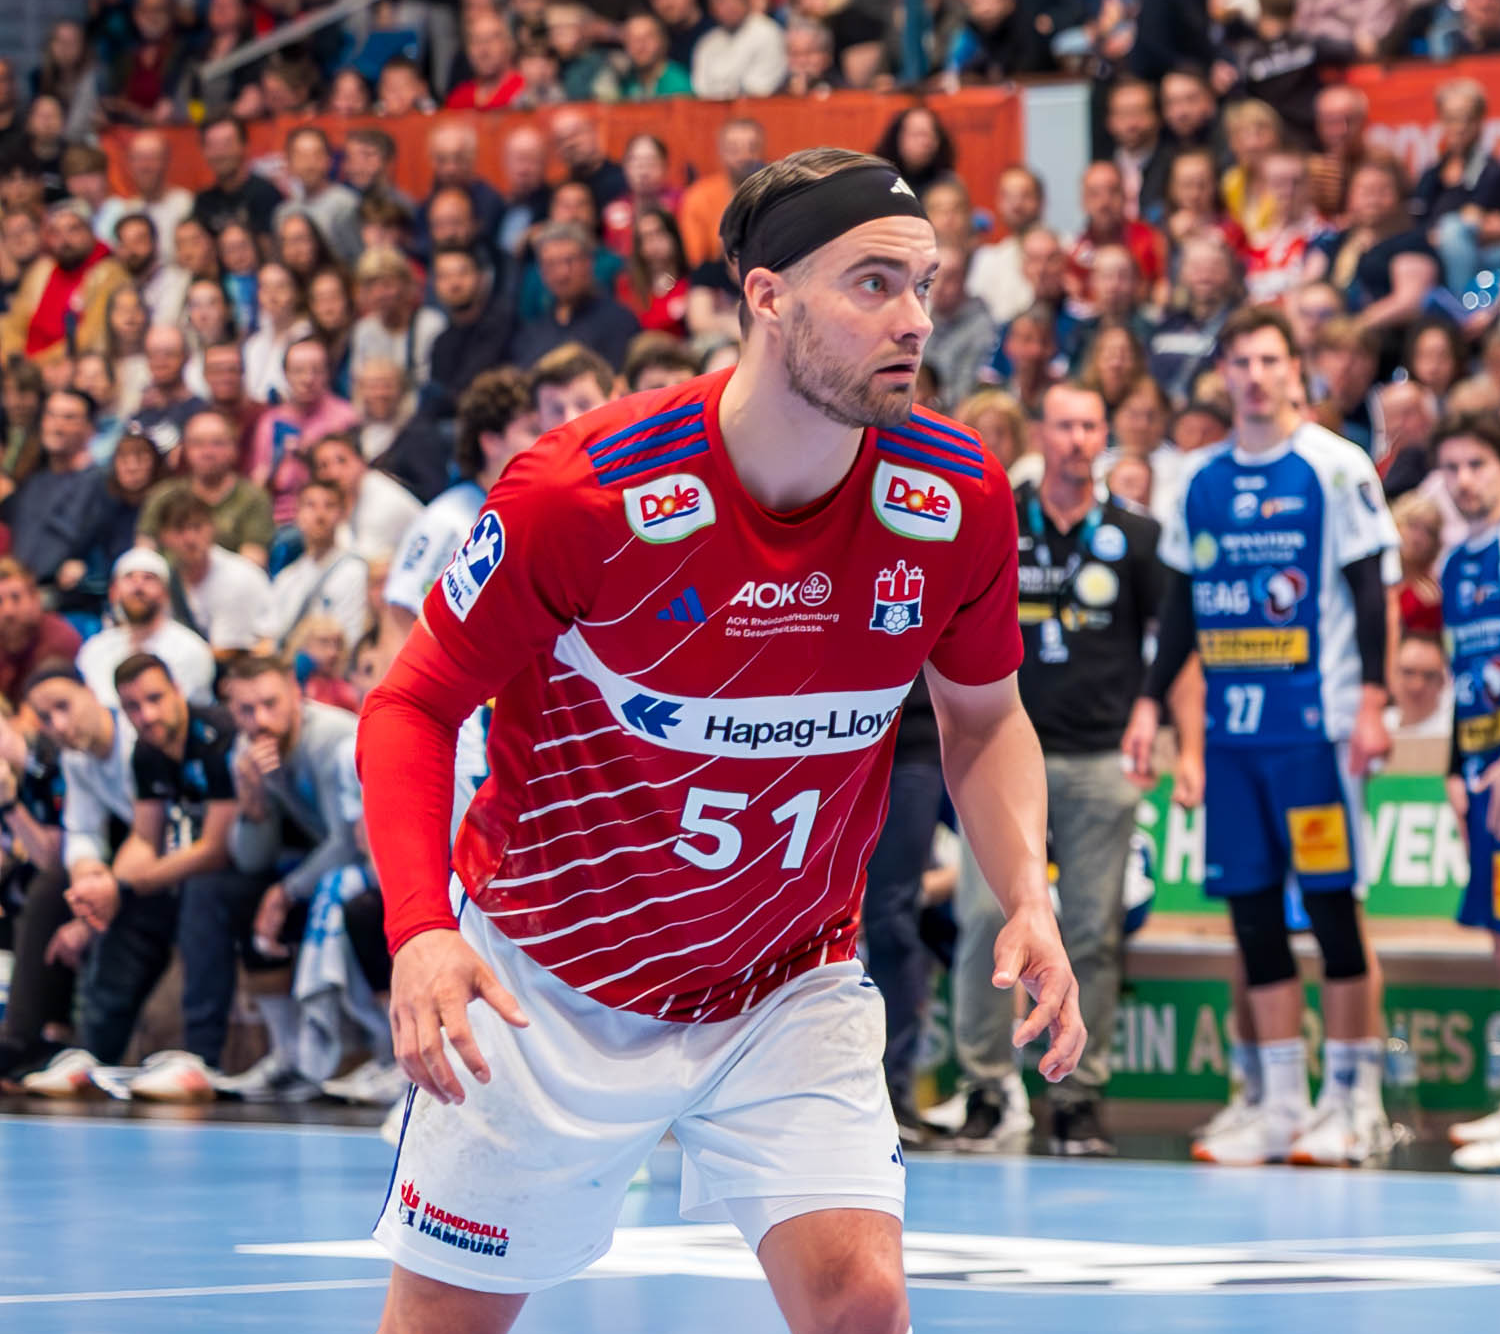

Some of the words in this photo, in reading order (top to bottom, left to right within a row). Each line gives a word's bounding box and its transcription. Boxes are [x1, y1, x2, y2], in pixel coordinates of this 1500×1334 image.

[640, 483, 700, 522] Dole
[884, 475, 951, 516] Dole
[729, 580, 800, 609] AOK
[725, 627, 742, 637] Die
[726, 616, 749, 626] AOK
[1224, 683, 1266, 734] 27
[672, 786, 821, 871] 51
[419, 1219, 507, 1257] HAMBURG
[423, 1202, 510, 1241] HANDBALL
